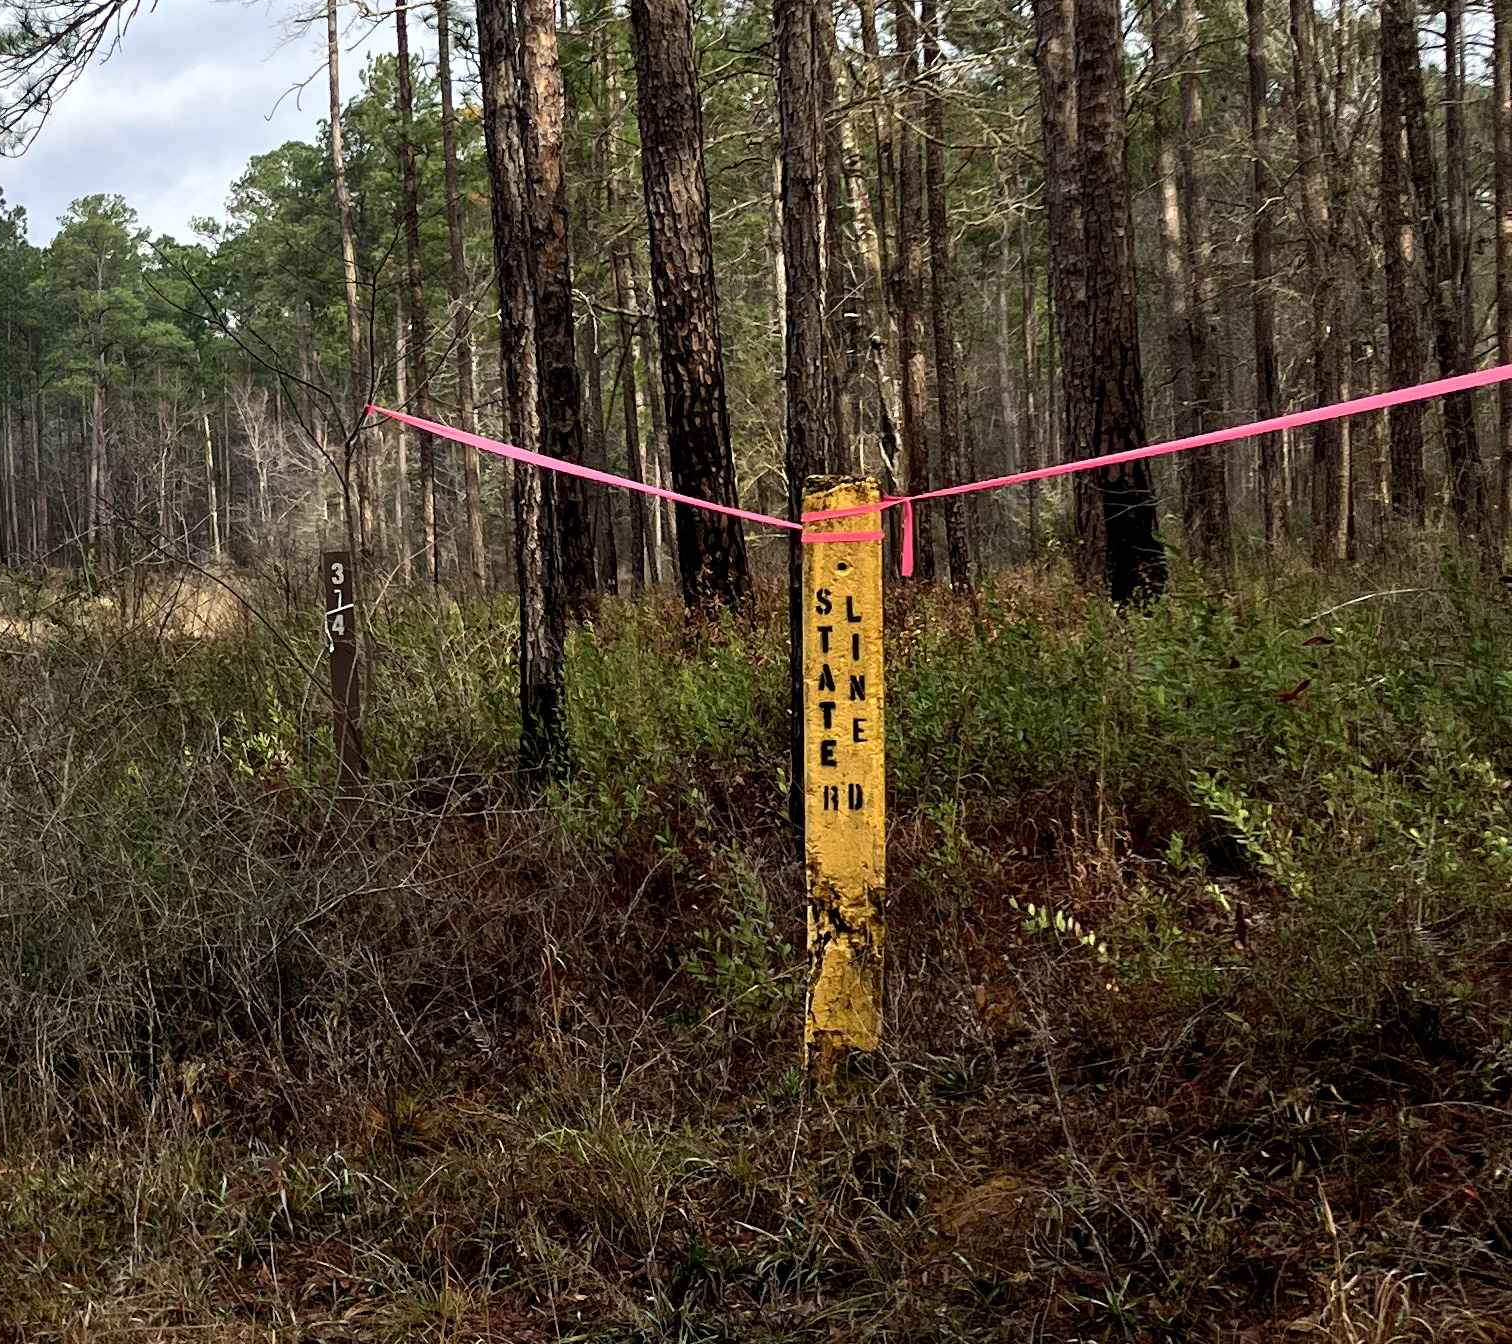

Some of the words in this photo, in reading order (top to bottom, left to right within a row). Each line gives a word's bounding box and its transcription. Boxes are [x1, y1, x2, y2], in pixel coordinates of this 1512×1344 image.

[816, 588, 837, 767] STATE
[846, 596, 867, 743] LINE
[823, 783, 863, 811] RD
